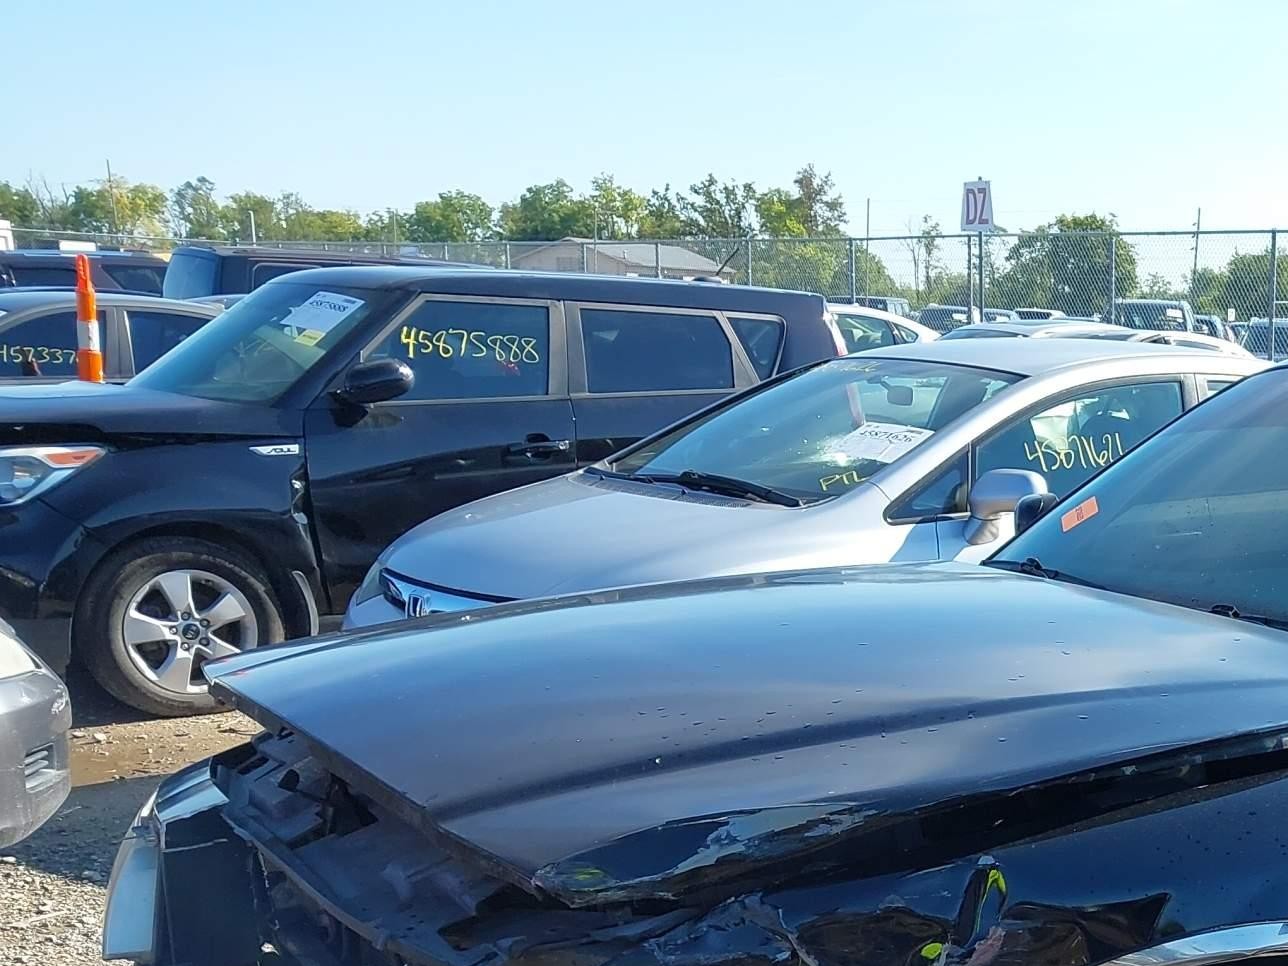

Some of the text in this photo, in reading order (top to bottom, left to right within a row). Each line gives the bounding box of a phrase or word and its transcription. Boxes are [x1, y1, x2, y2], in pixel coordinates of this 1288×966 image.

[966, 188, 989, 224] DZ
[0, 344, 79, 363] 457337
[401, 326, 539, 363] 45875888
